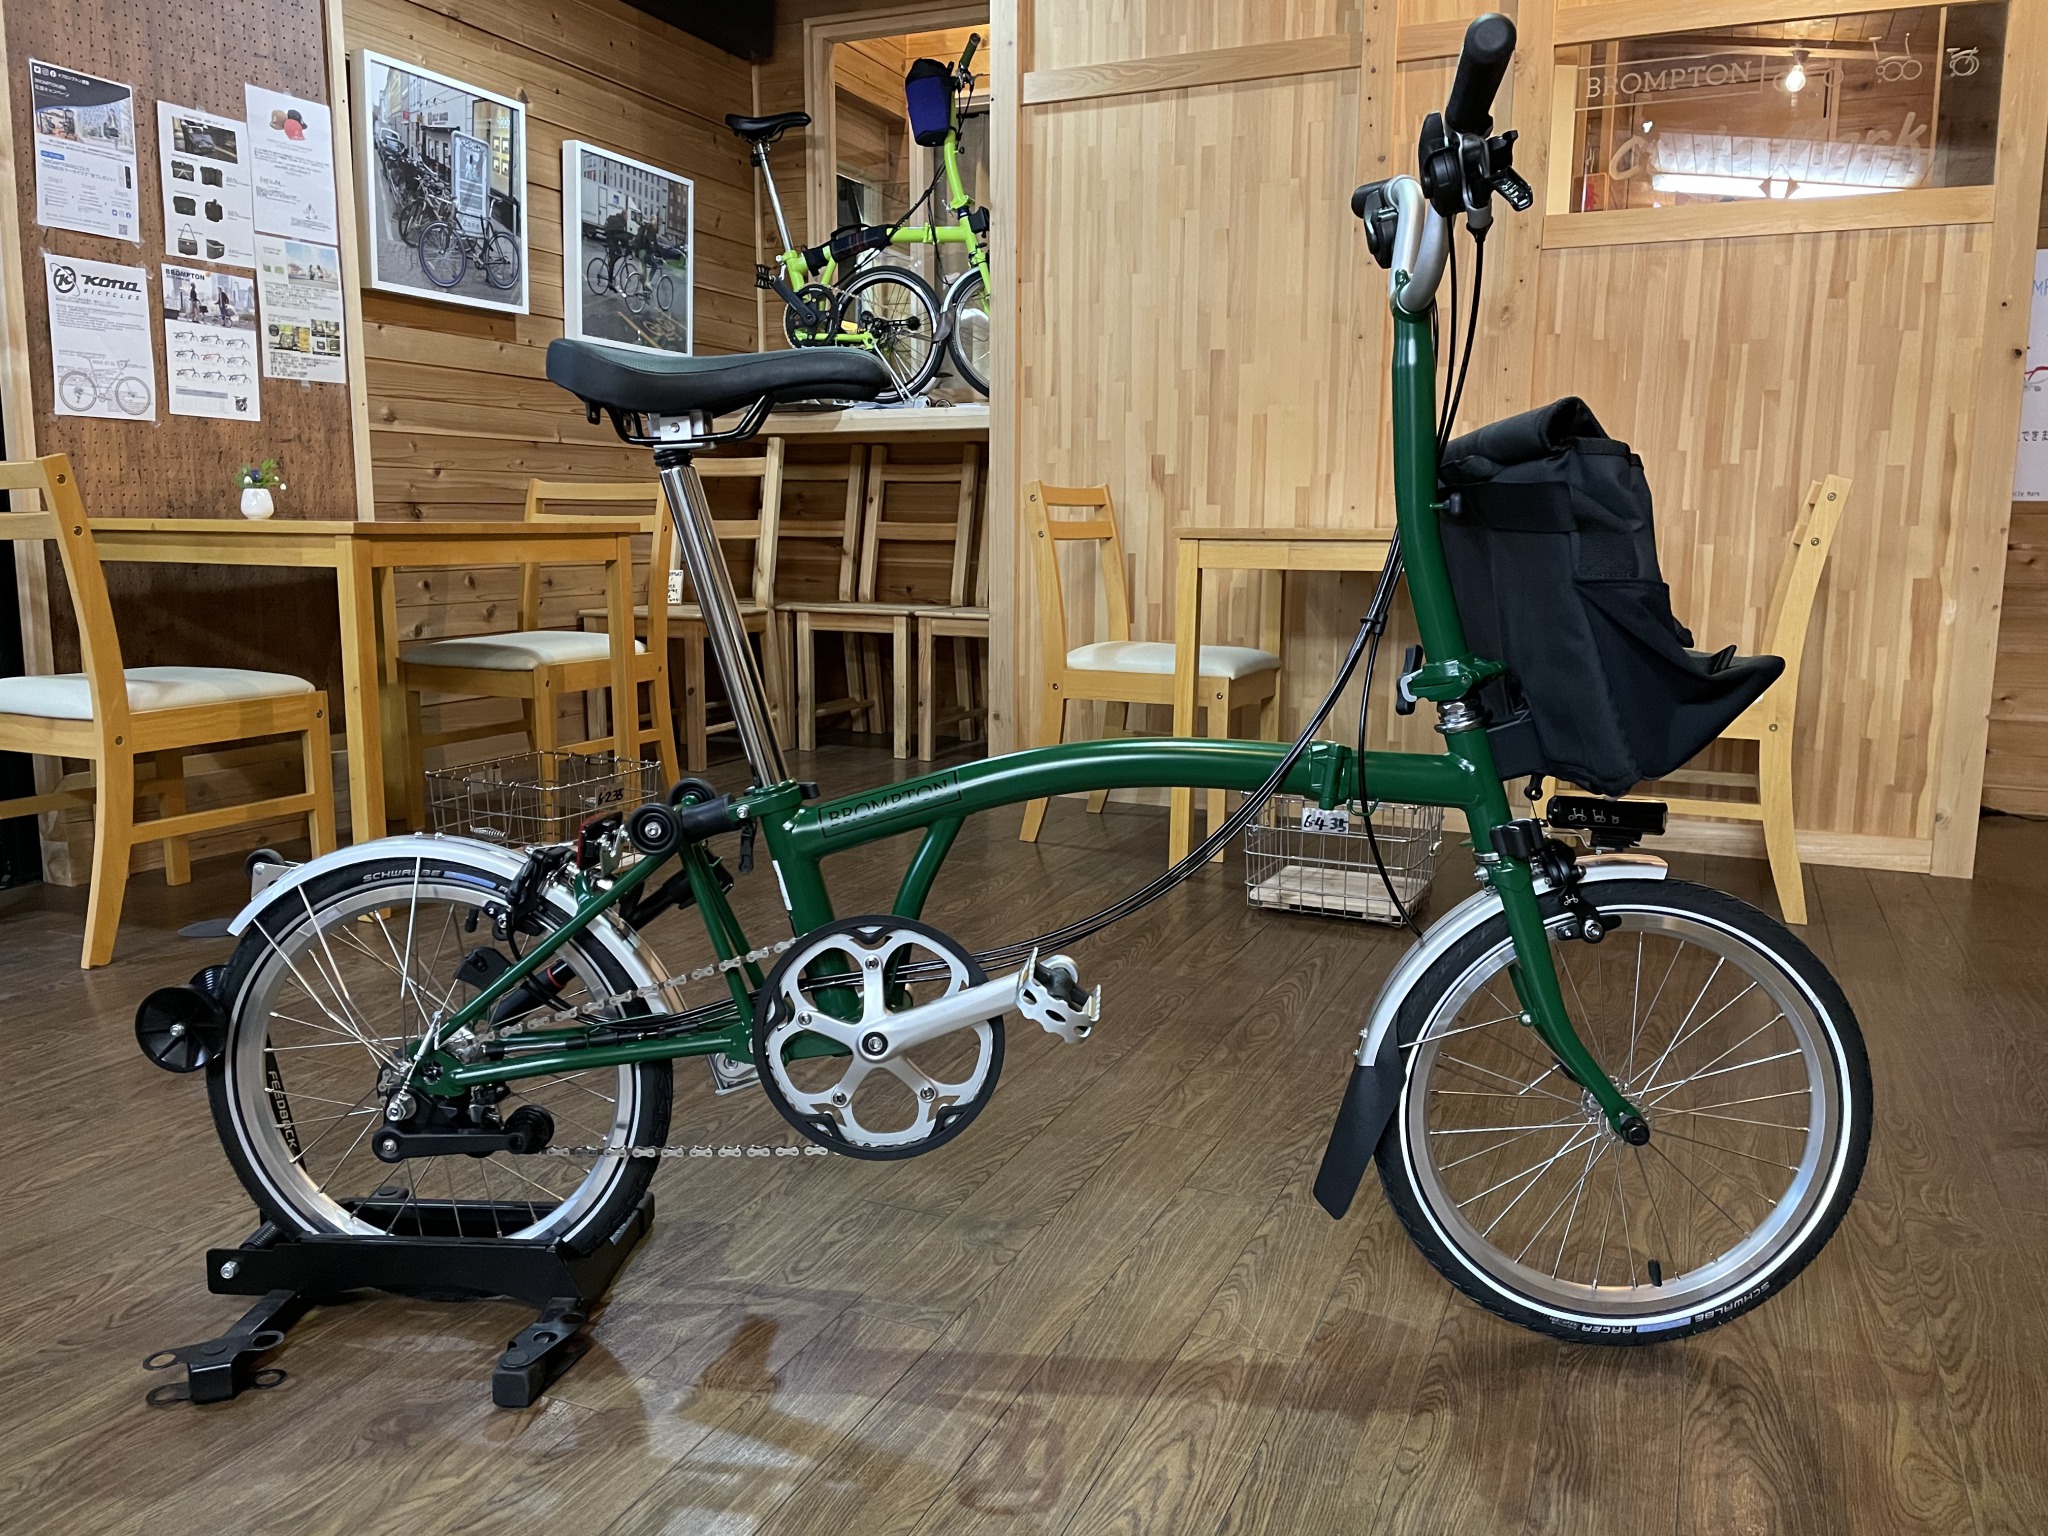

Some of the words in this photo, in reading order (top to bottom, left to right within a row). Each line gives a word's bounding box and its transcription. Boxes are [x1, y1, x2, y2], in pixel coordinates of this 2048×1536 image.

[1586, 61, 1752, 98] BROMPTON
[165, 268, 206, 281] BROMPTON
[83, 288, 140, 301] BICYCLES
[828, 780, 949, 828] BROMPTON
[268, 1070, 298, 1149] FEEDBACK
[1694, 1280, 1771, 1323] SCHWALBE
[1581, 1324, 1633, 1334] RACER
